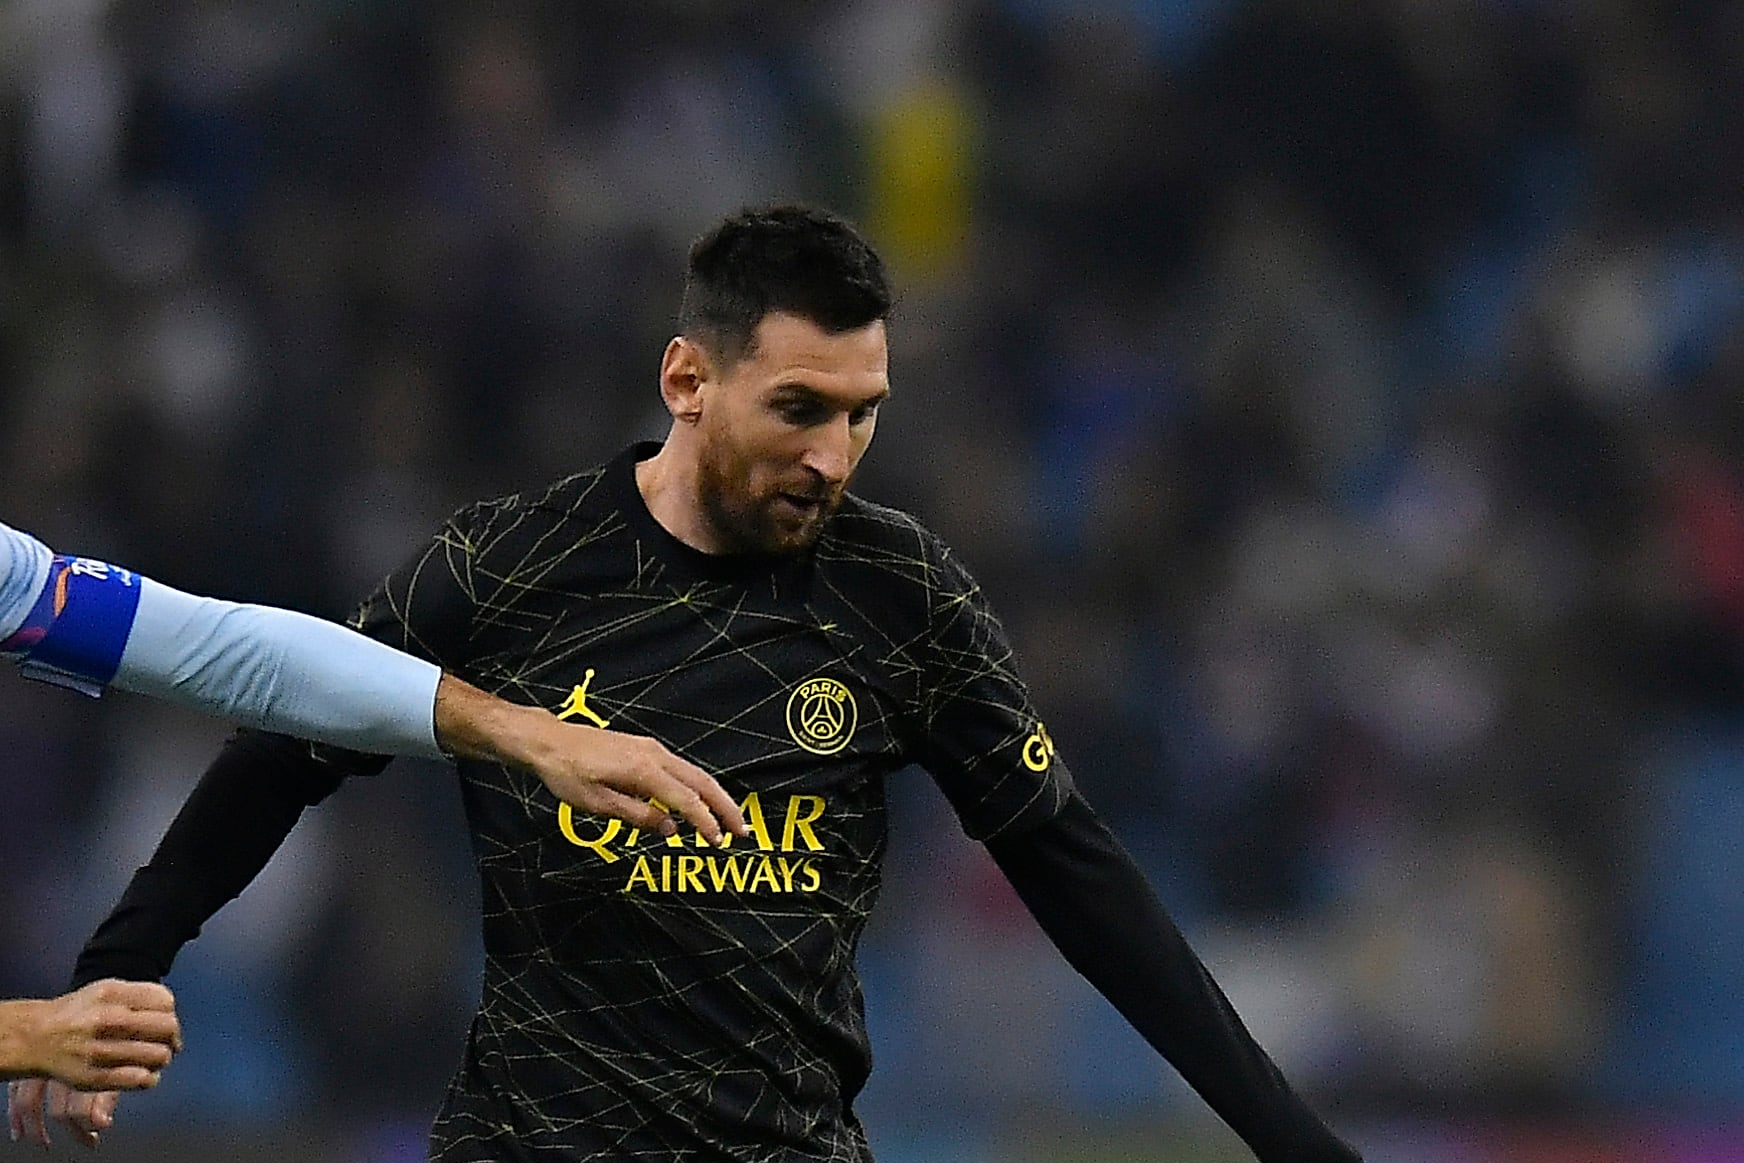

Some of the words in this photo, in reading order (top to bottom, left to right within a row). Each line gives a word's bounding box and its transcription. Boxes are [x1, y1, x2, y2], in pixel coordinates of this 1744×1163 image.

[799, 682, 847, 702] PARIS
[558, 791, 825, 863] QAR
[625, 855, 821, 893] AIRWAYS
